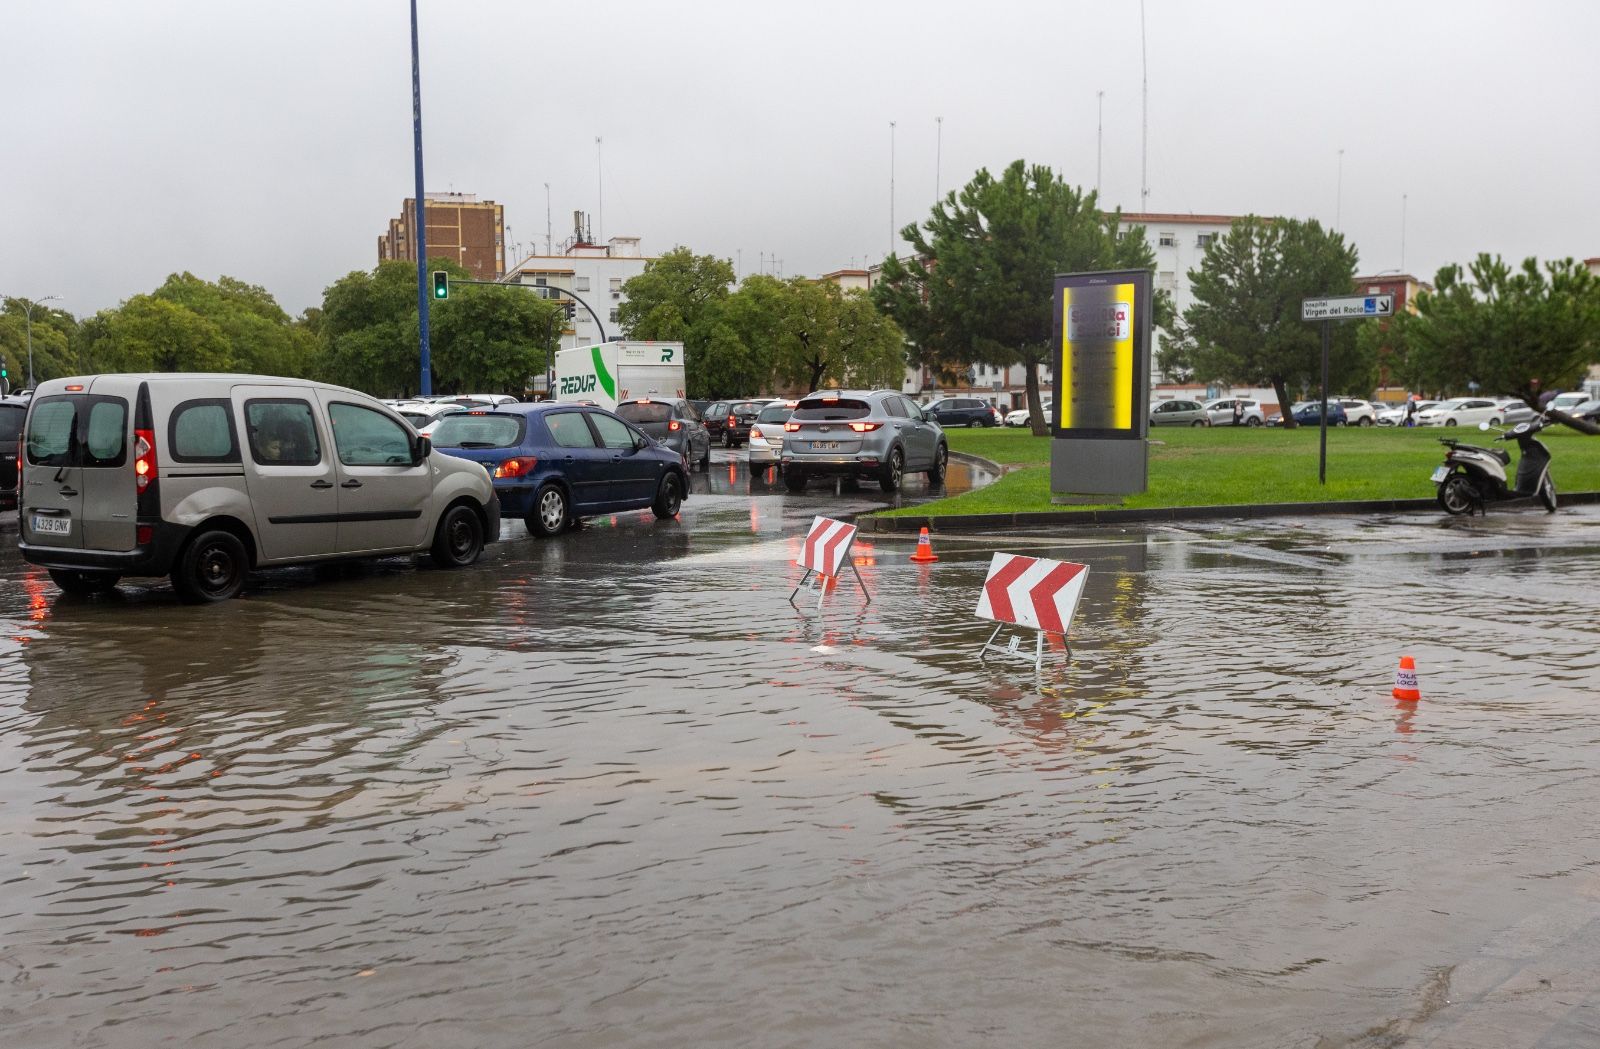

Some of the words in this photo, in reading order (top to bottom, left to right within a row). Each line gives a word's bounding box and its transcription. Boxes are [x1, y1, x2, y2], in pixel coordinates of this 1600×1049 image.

[1305, 308, 1327, 317] Virgen
[1329, 306, 1341, 315] del
[560, 374, 597, 395] REDUR
[37, 518, 53, 530] 4329
[54, 519, 69, 532] GNK
